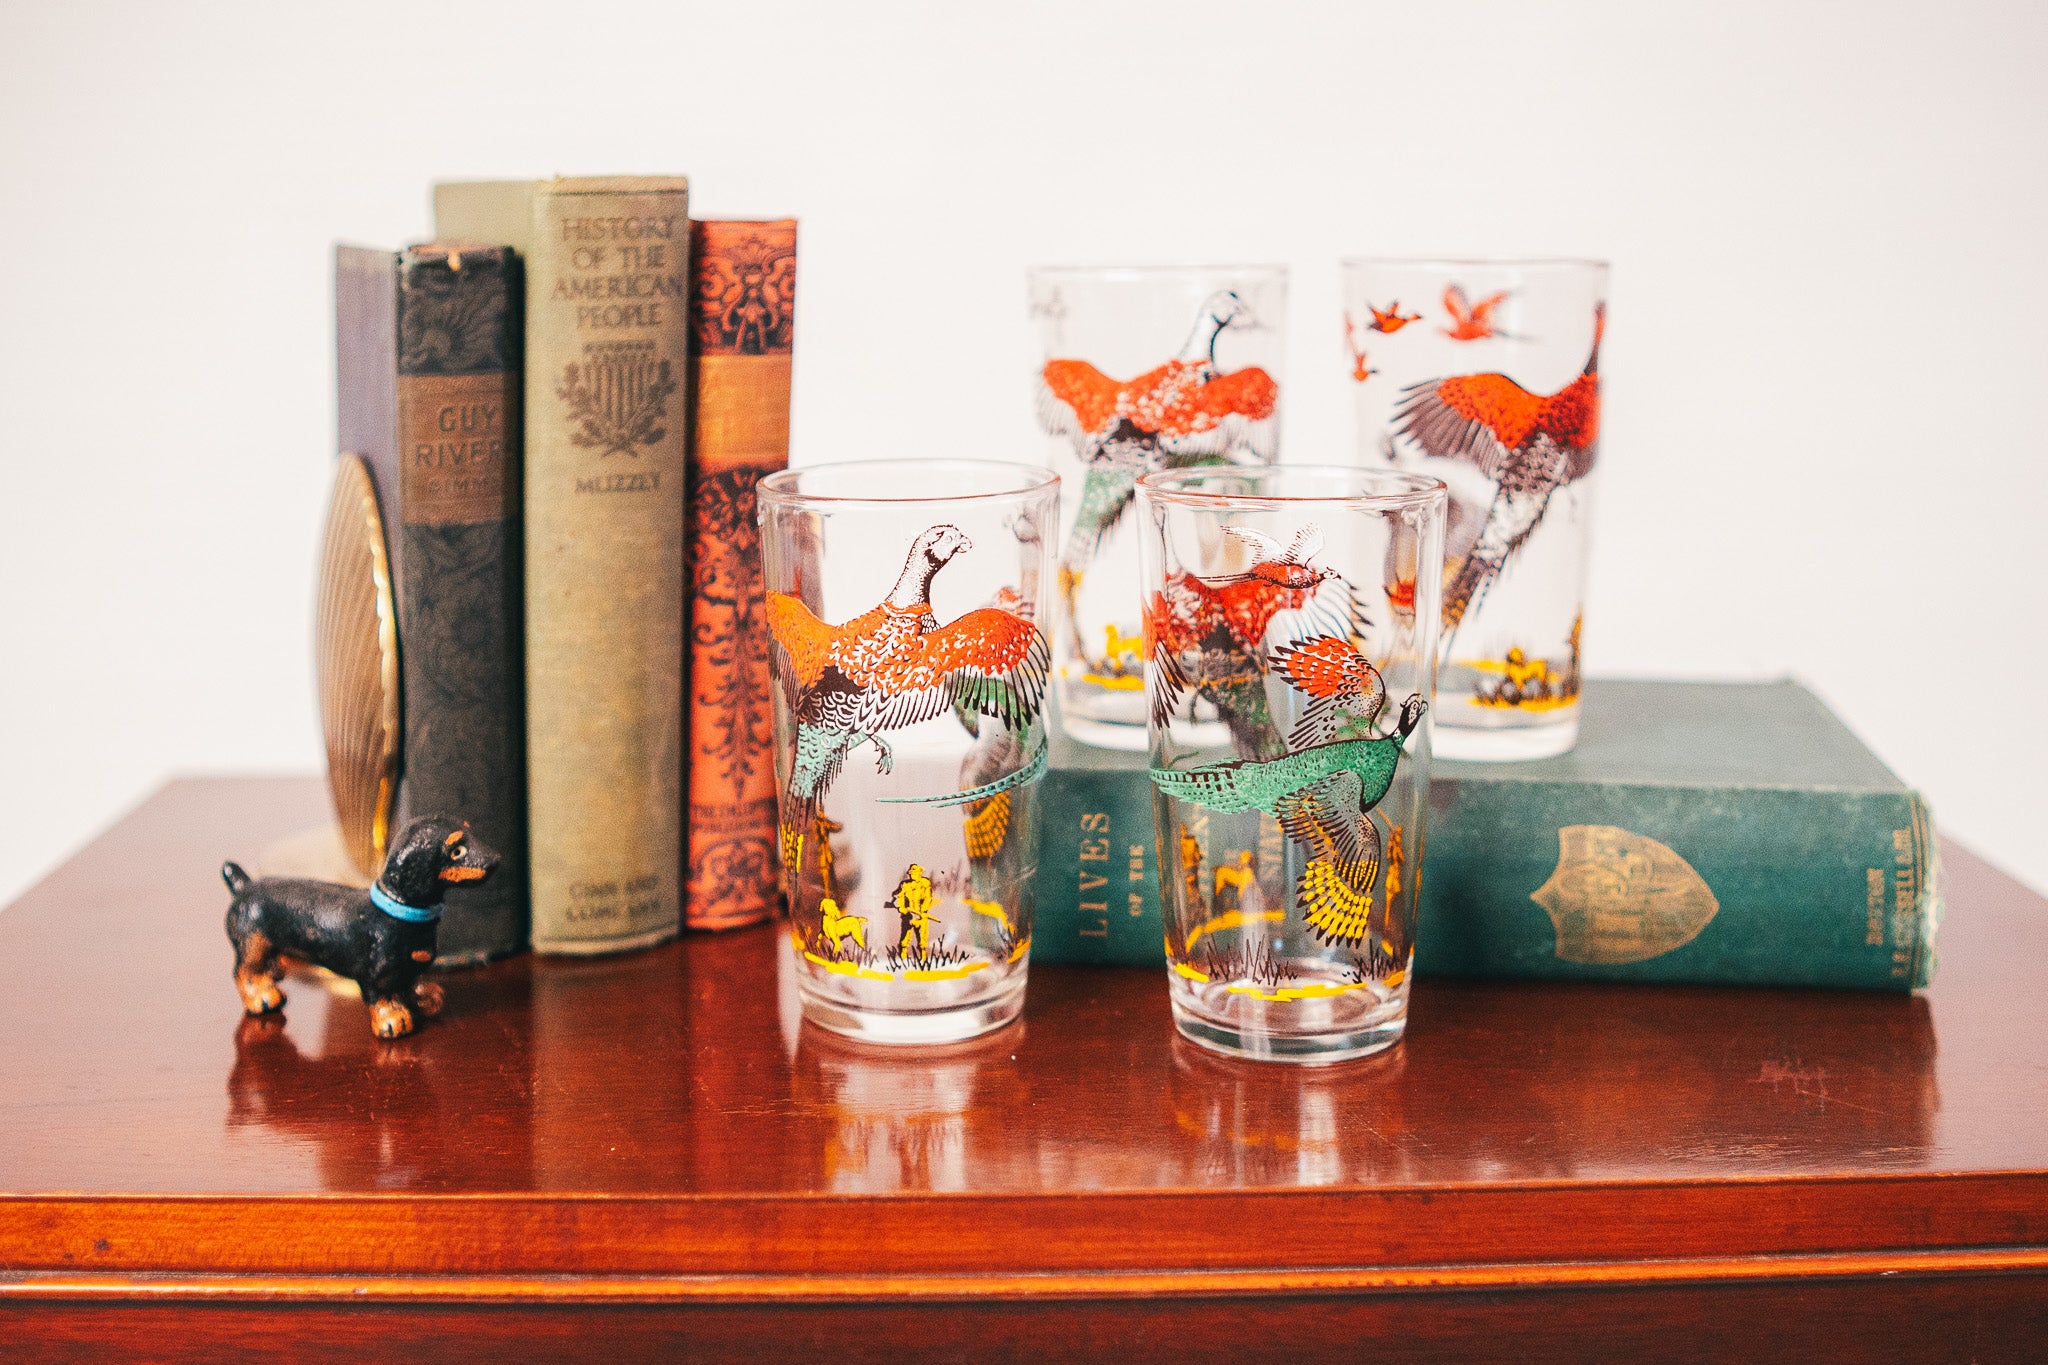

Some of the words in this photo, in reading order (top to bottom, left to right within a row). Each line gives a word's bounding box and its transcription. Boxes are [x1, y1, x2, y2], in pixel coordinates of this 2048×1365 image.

[561, 215, 676, 241] HISTORY
[572, 246, 605, 270] OF
[617, 245, 665, 268] THE
[551, 274, 683, 299] AMERICAN
[576, 302, 663, 330] PEOPLE
[439, 404, 498, 433] GUY
[575, 472, 661, 493] MUZZEY
[1079, 812, 1110, 938] LIVES
